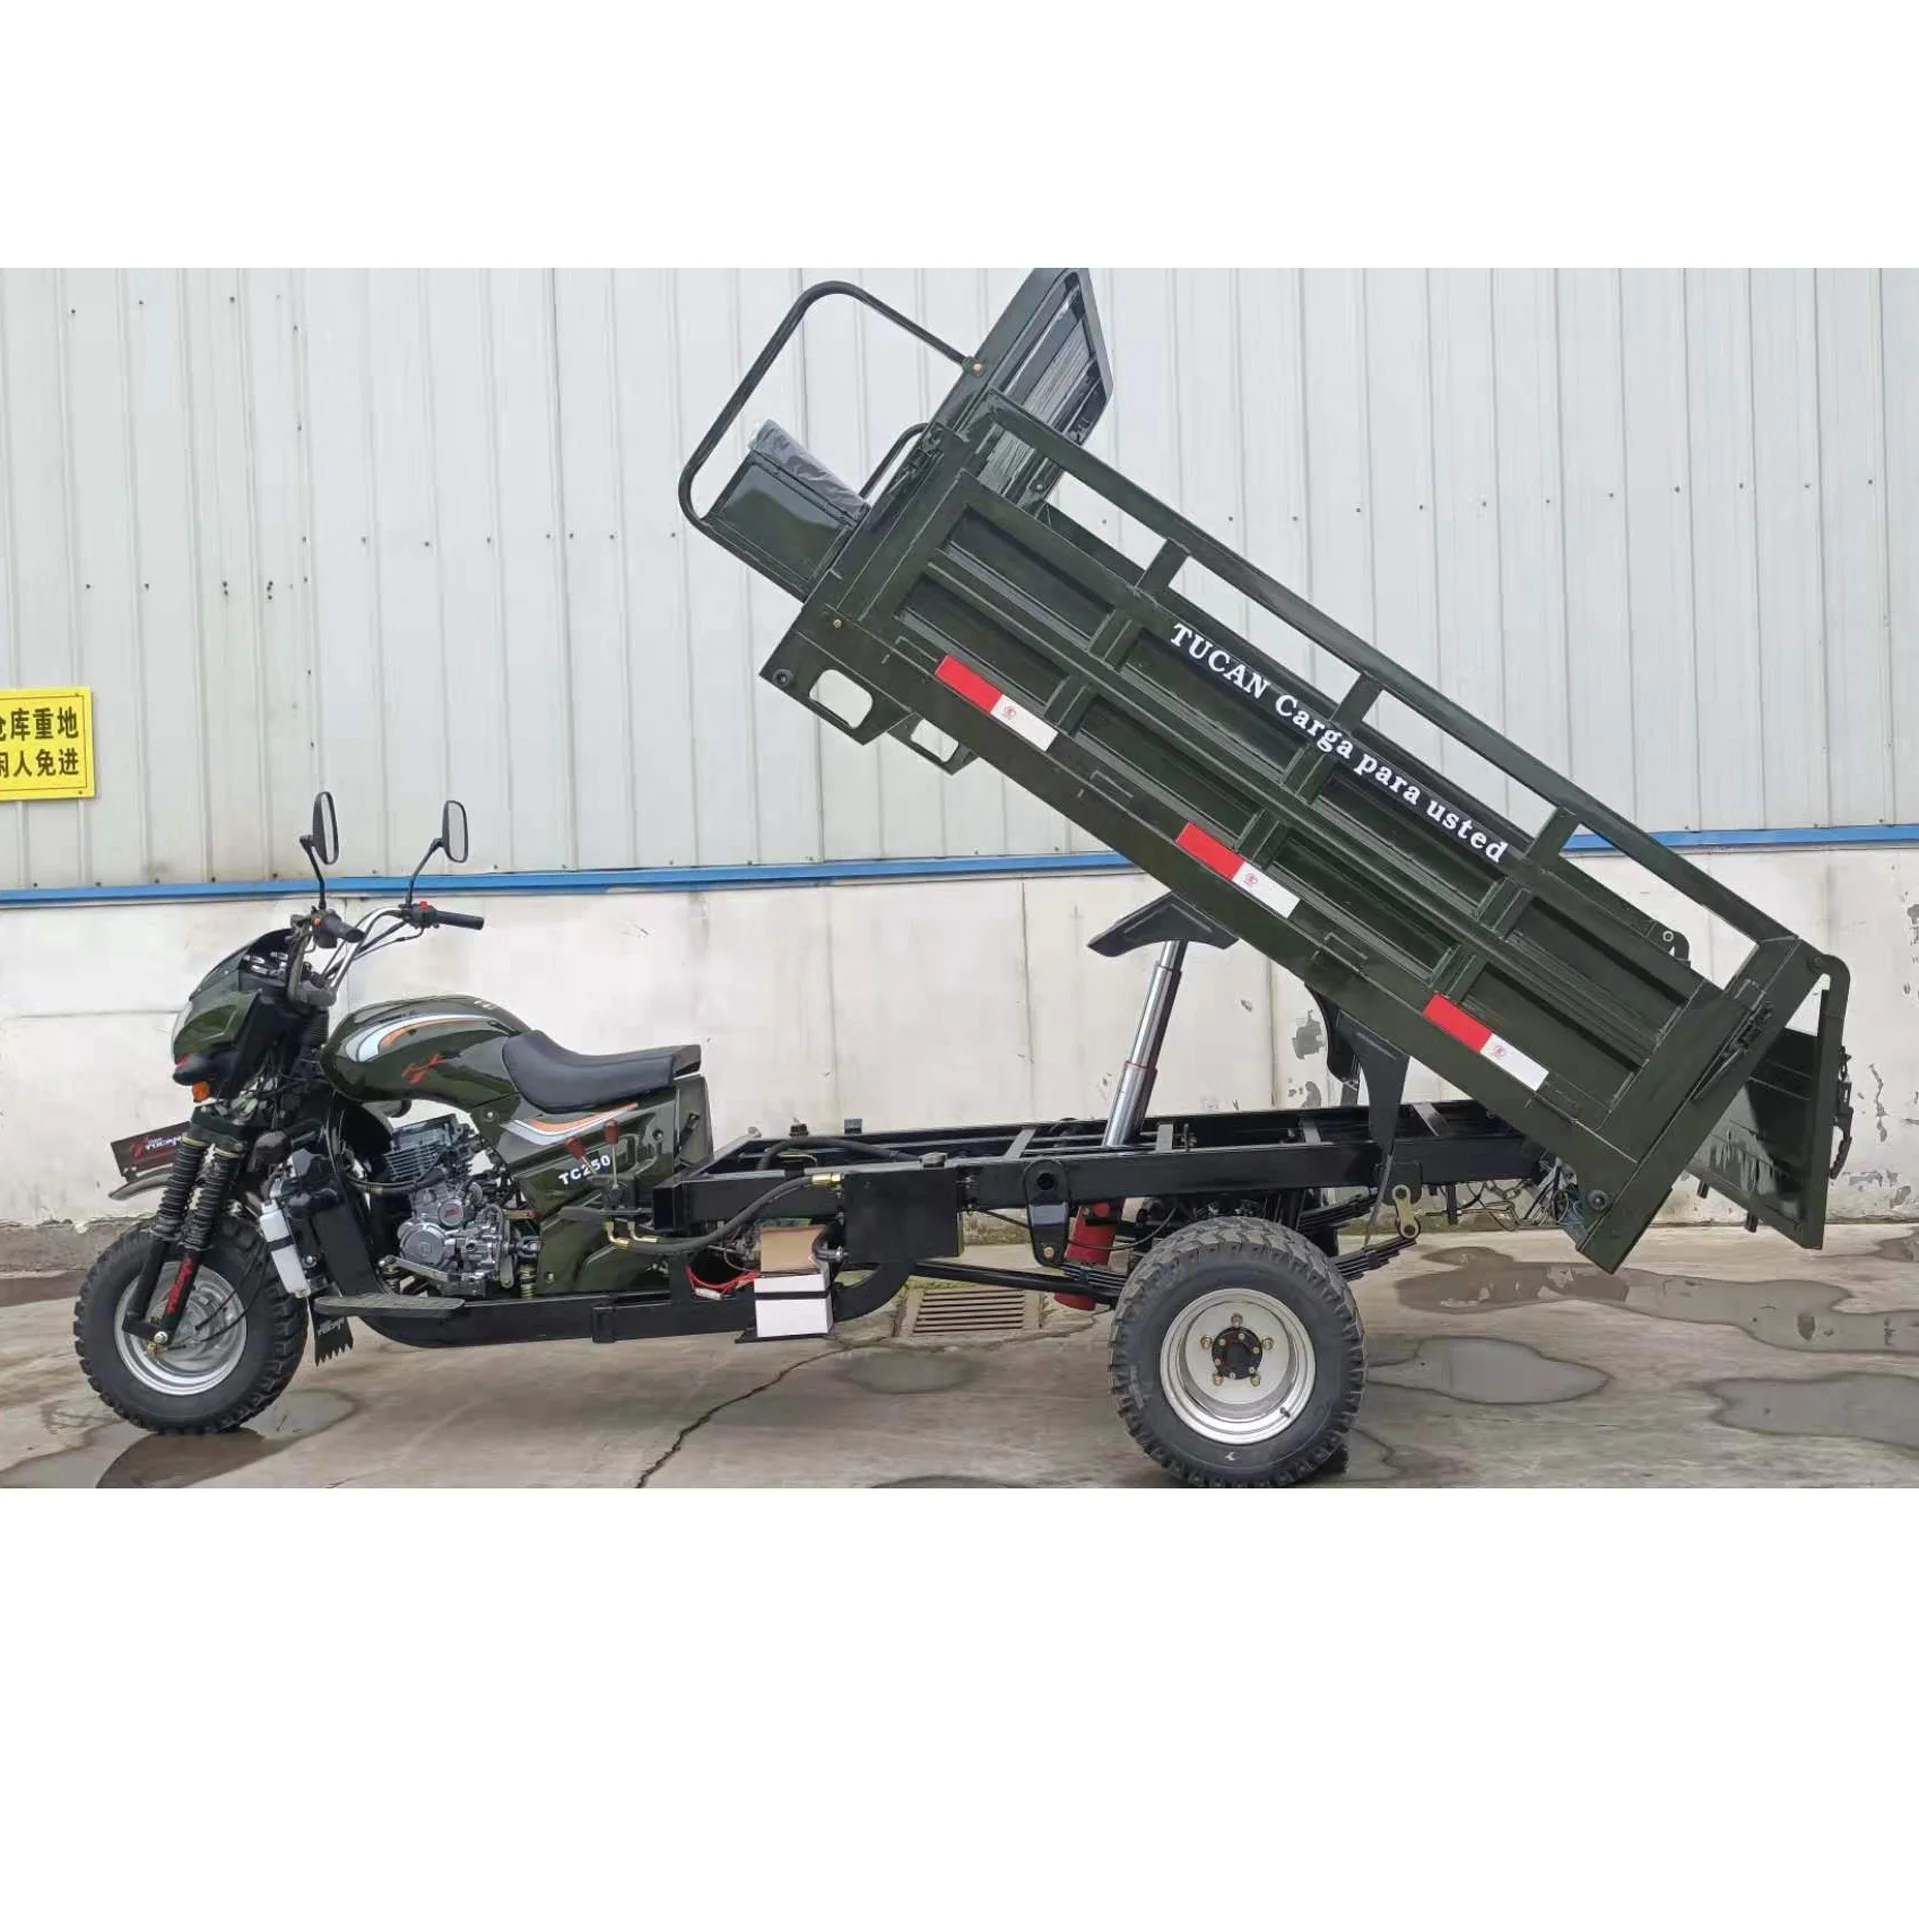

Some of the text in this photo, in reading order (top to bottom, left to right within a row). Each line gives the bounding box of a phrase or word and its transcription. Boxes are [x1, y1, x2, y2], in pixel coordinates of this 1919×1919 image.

[1170, 622, 1509, 863] TUCAN Carga para usted
[558, 1155, 611, 1185] TC250
